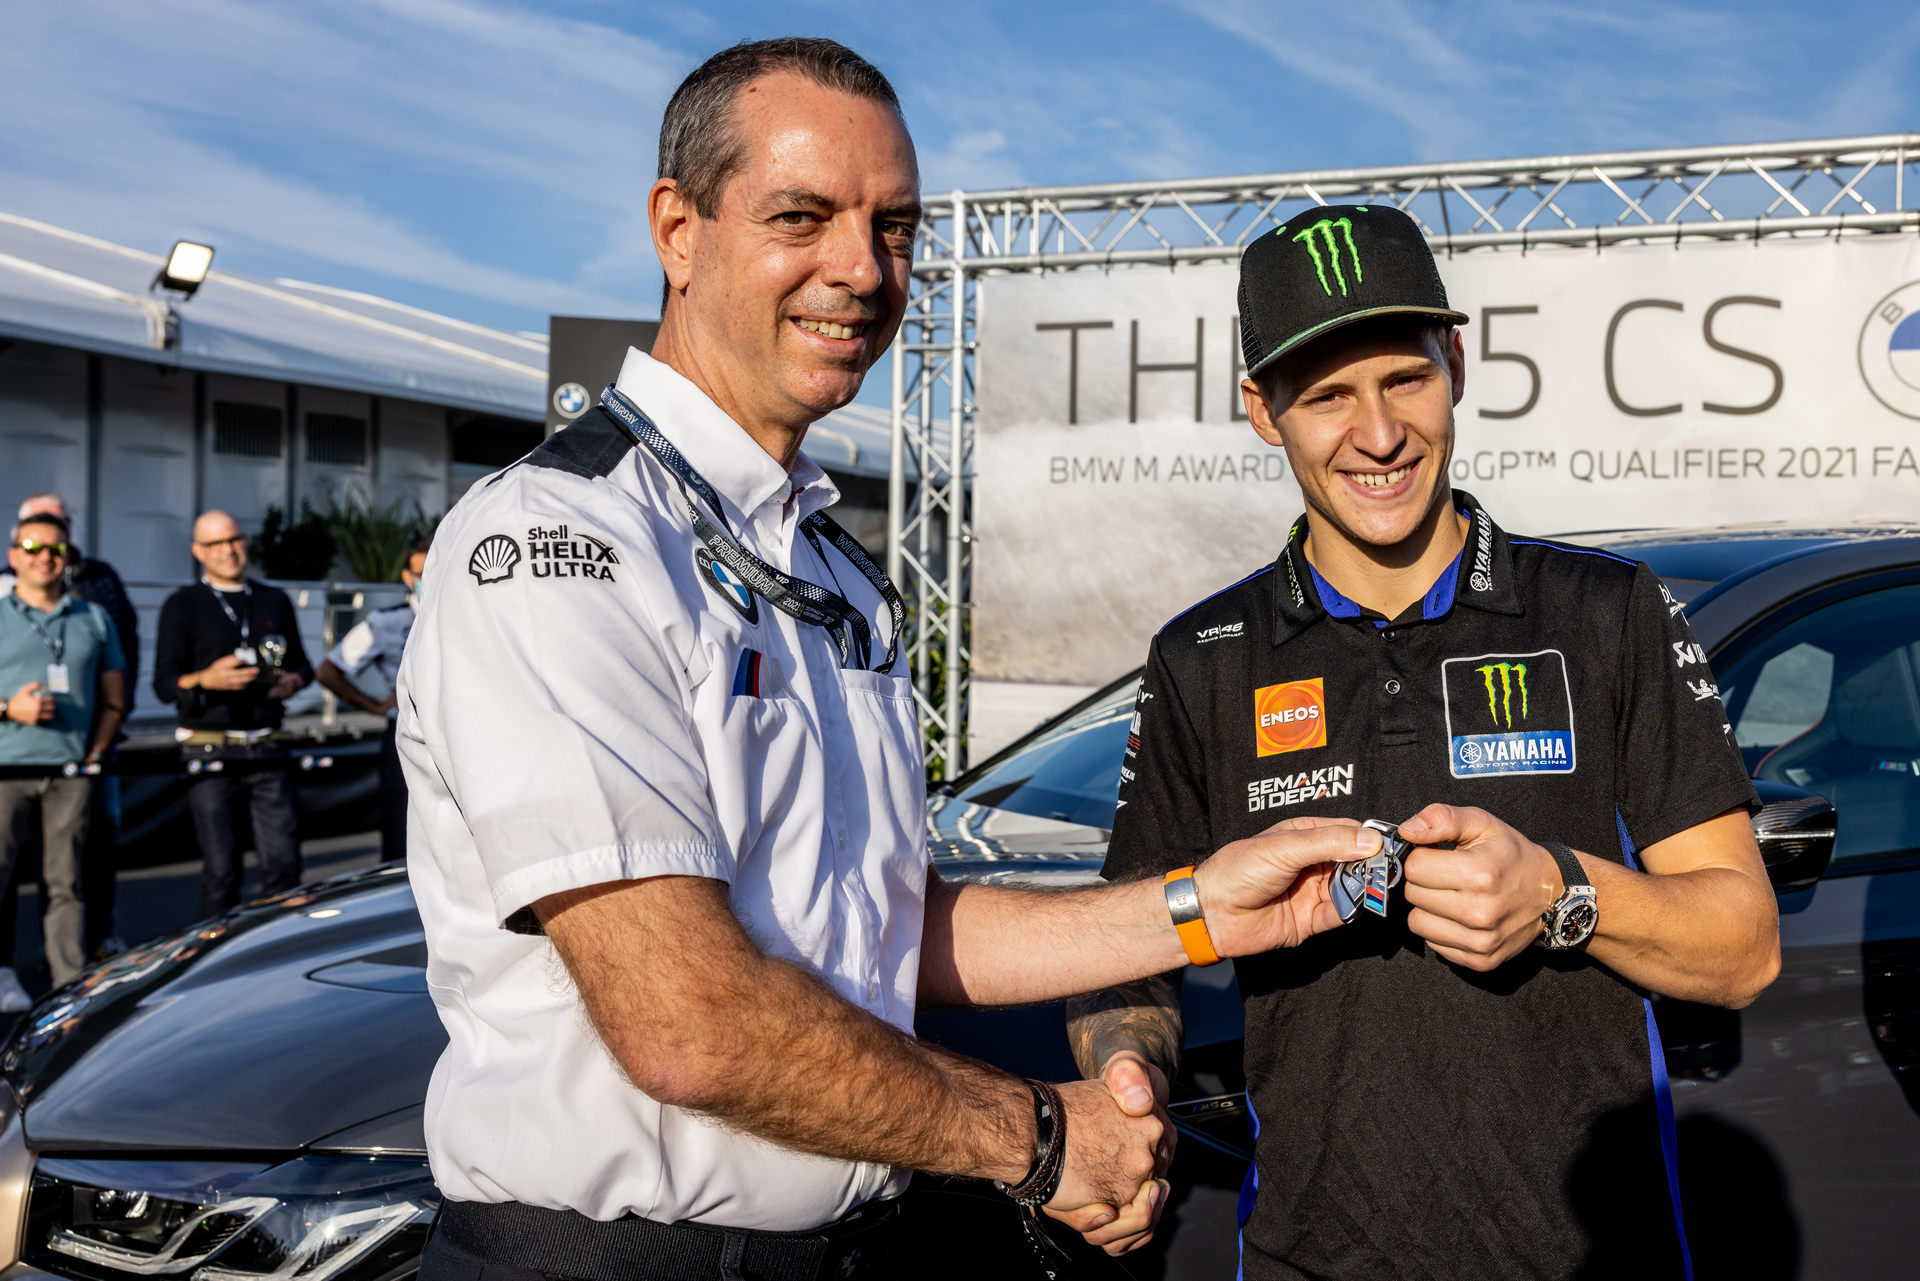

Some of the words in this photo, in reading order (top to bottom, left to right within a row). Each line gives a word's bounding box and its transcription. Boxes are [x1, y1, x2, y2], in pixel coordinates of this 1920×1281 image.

[1036, 316, 1251, 425] TH
[1478, 305, 1542, 420] 5
[1603, 295, 1784, 417] CS
[607, 396, 640, 425] SATURDAY
[1050, 456, 1125, 484] BMW
[1135, 456, 1159, 482] M
[1168, 453, 1285, 482] AWARD
[1569, 448, 1766, 483] QUALIFIER
[1776, 446, 1858, 478] 2021
[528, 525, 569, 540] Shell
[1474, 508, 1490, 573] YAMAHA
[528, 540, 618, 564] HELIX
[836, 533, 889, 591] PREMIUM
[531, 561, 616, 583] ULTRA
[708, 534, 775, 595] PREMIUM
[775, 572, 790, 585] VIP
[783, 597, 801, 613] 2021
[1260, 704, 1320, 728] ENEOS
[1483, 738, 1567, 761] YAMAHA
[1460, 760, 1517, 769] FACTORY
[1268, 779, 1353, 809] DEPAN
